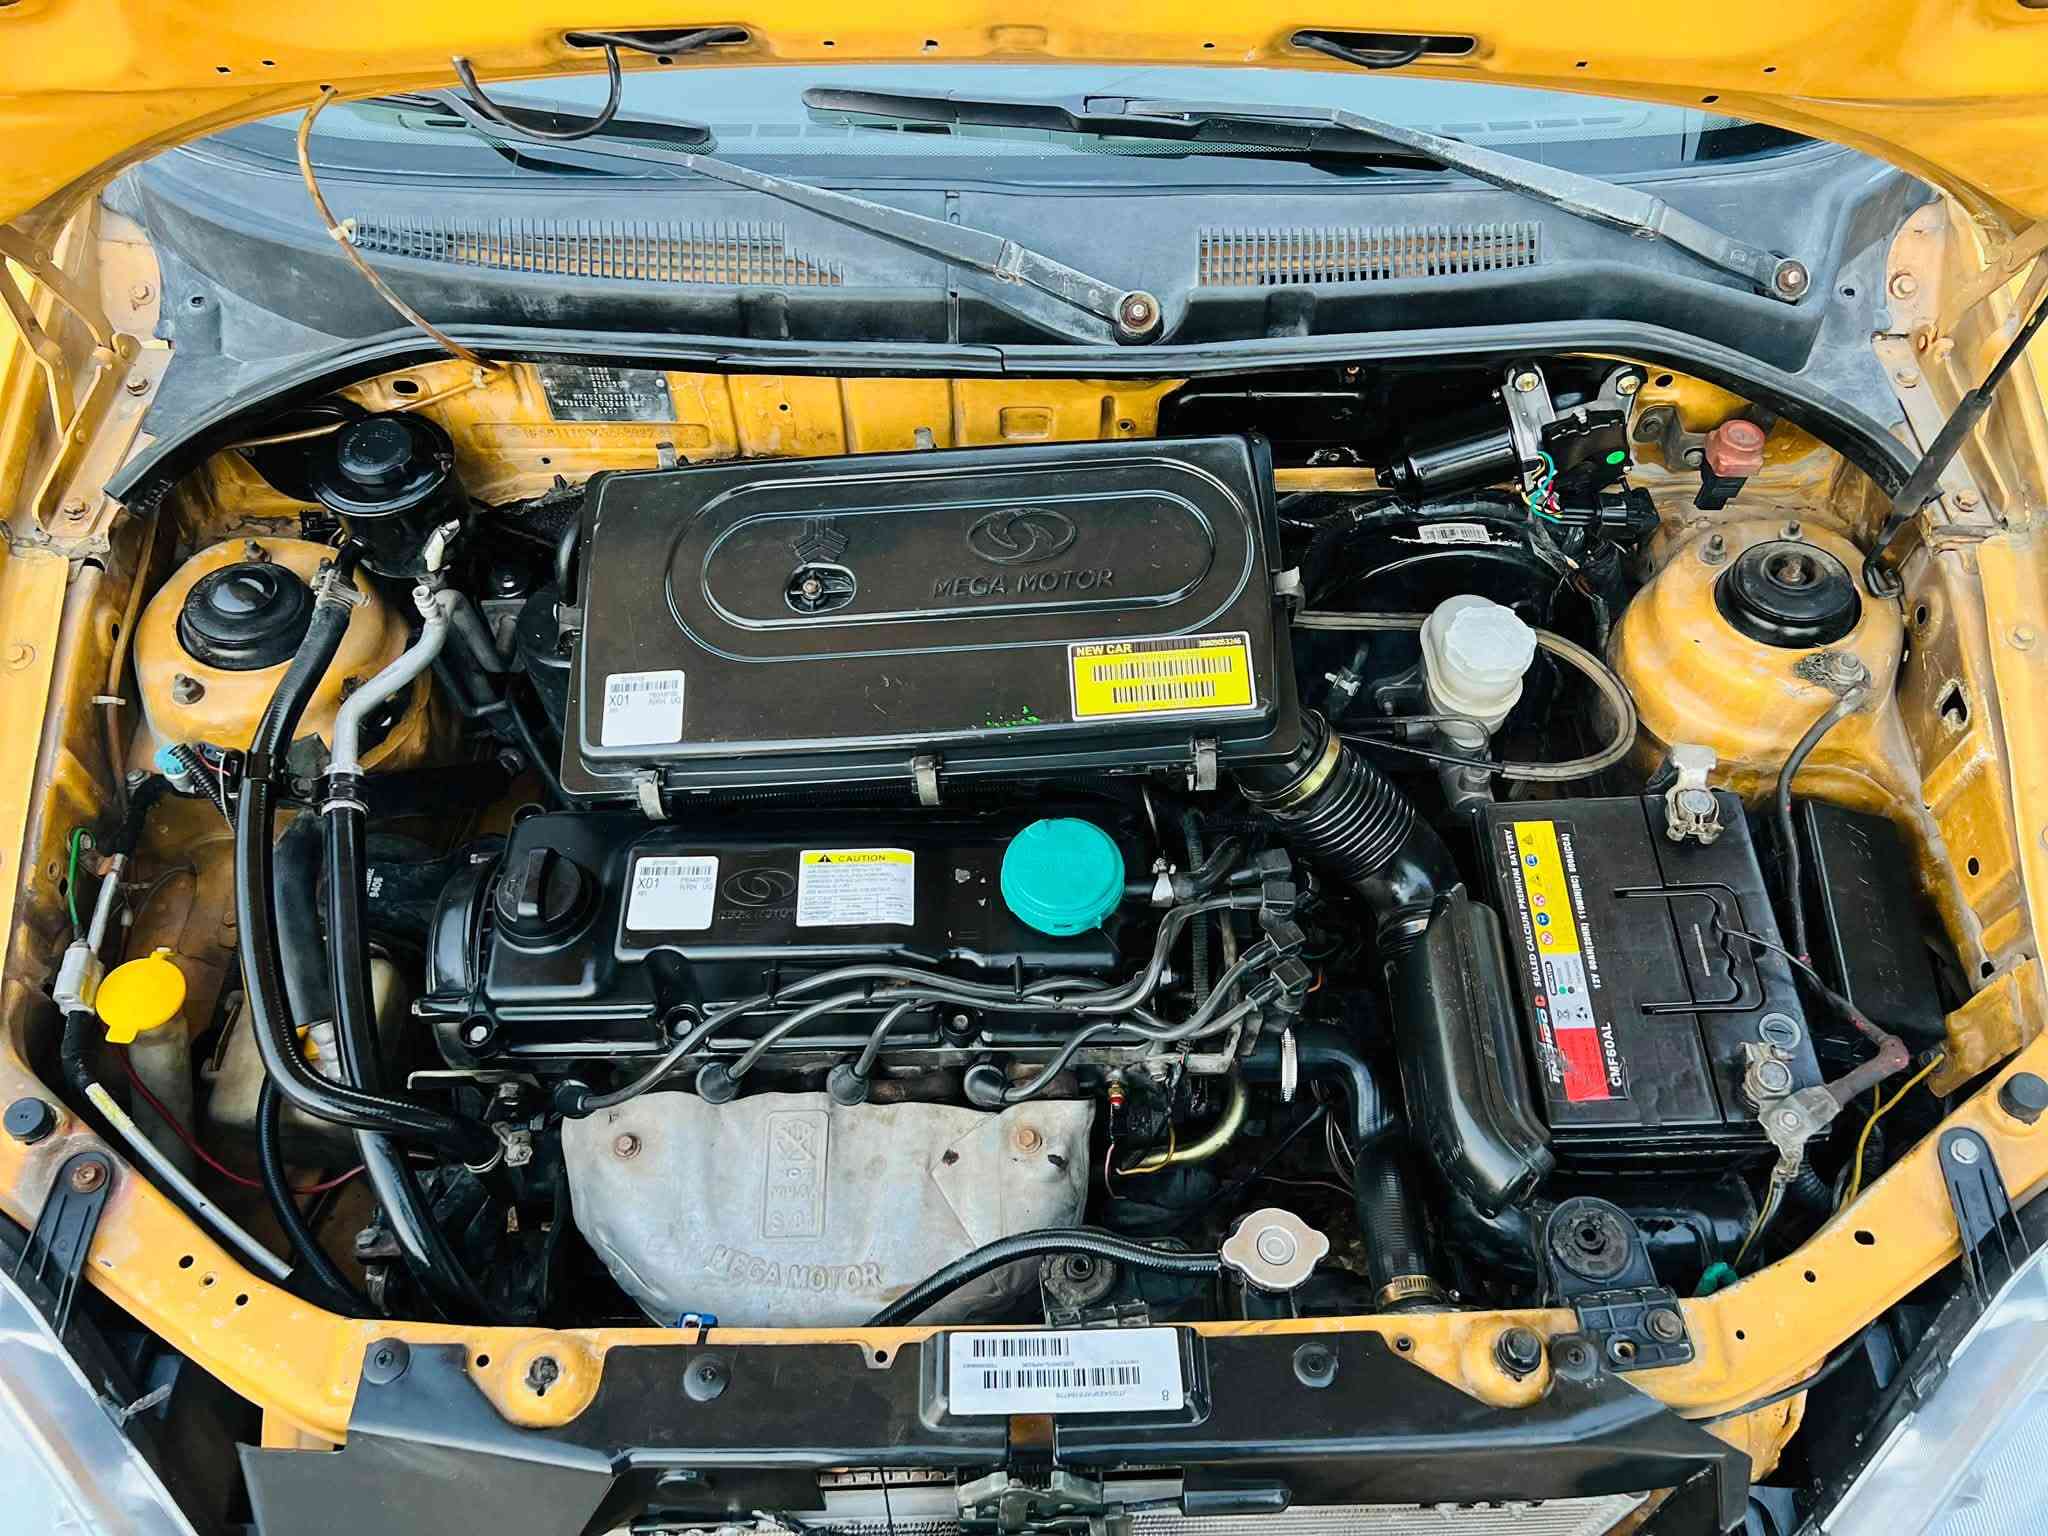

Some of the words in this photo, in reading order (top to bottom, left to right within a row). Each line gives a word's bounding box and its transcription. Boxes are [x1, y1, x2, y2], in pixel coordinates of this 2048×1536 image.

[933, 576, 1008, 599] MEGA
[1017, 568, 1113, 593] MOTOR
[1076, 645, 1104, 657] NEW
[1106, 643, 1133, 655] CAR
[608, 693, 629, 706] X01
[838, 854, 886, 863] CAUTION
[1504, 829, 1518, 866] BATTERY
[636, 877, 660, 889] X01
[1512, 867, 1528, 910] PREMIUM
[1520, 911, 1535, 952] CALCIUM
[1528, 953, 1542, 988] SEALED
[1602, 1022, 1622, 1087] CMF60AL
[706, 1244, 782, 1287] MEGA
[787, 1262, 883, 1294] MOTOR
